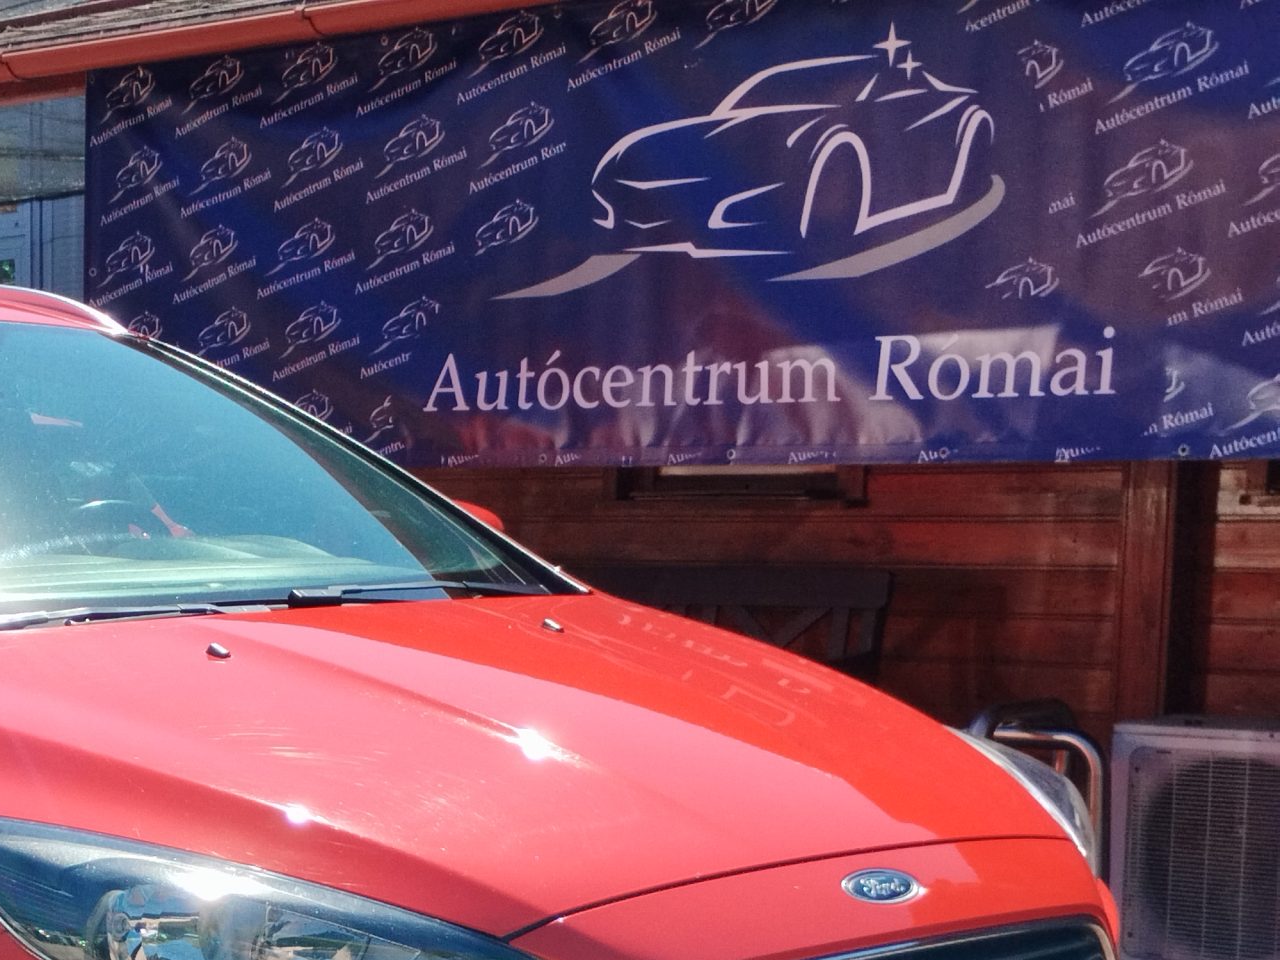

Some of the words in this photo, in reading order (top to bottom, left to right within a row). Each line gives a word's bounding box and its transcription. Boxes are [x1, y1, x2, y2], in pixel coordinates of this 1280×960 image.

[457, 65, 528, 105] Autócentrum
[530, 42, 567, 68] Római
[567, 51, 642, 92] Autócentrum
[644, 27, 681, 55] Római
[259, 93, 324, 128] Autócentrum
[326, 72, 358, 97] Római
[355, 81, 421, 118] Autócentrum
[424, 57, 457, 82] Római
[1047, 77, 1094, 110] Római
[1094, 86, 1192, 135] Autócentrum
[1197, 60, 1250, 92] Római
[89, 114, 144, 148] Autócentrum
[174, 105, 229, 139] Autócentrum
[180, 185, 242, 218] Autócentrum
[243, 168, 272, 191] Római
[273, 178, 332, 212] Autócentrum
[333, 157, 364, 182] Római
[365, 167, 431, 204] Autócentrum
[433, 147, 467, 171] Római
[469, 156, 538, 195] Autócentrum
[100, 194, 153, 227] Autócentrum
[1076, 203, 1172, 248] Autócentrum
[1175, 178, 1227, 210] Római
[172, 272, 227, 305] Autócentrum
[227, 256, 257, 279] Római
[256, 265, 321, 300] Autócentrum
[323, 249, 356, 273] Római
[354, 260, 420, 295] Autócentrum
[422, 241, 455, 266] Római
[1191, 288, 1243, 317] Római
[242, 337, 271, 360] Római
[272, 349, 327, 382] Autócentrum
[328, 334, 360, 357] Római
[423, 351, 841, 414] Autócentrum
[869, 326, 1117, 401] Római
[1162, 402, 1214, 430] Római
